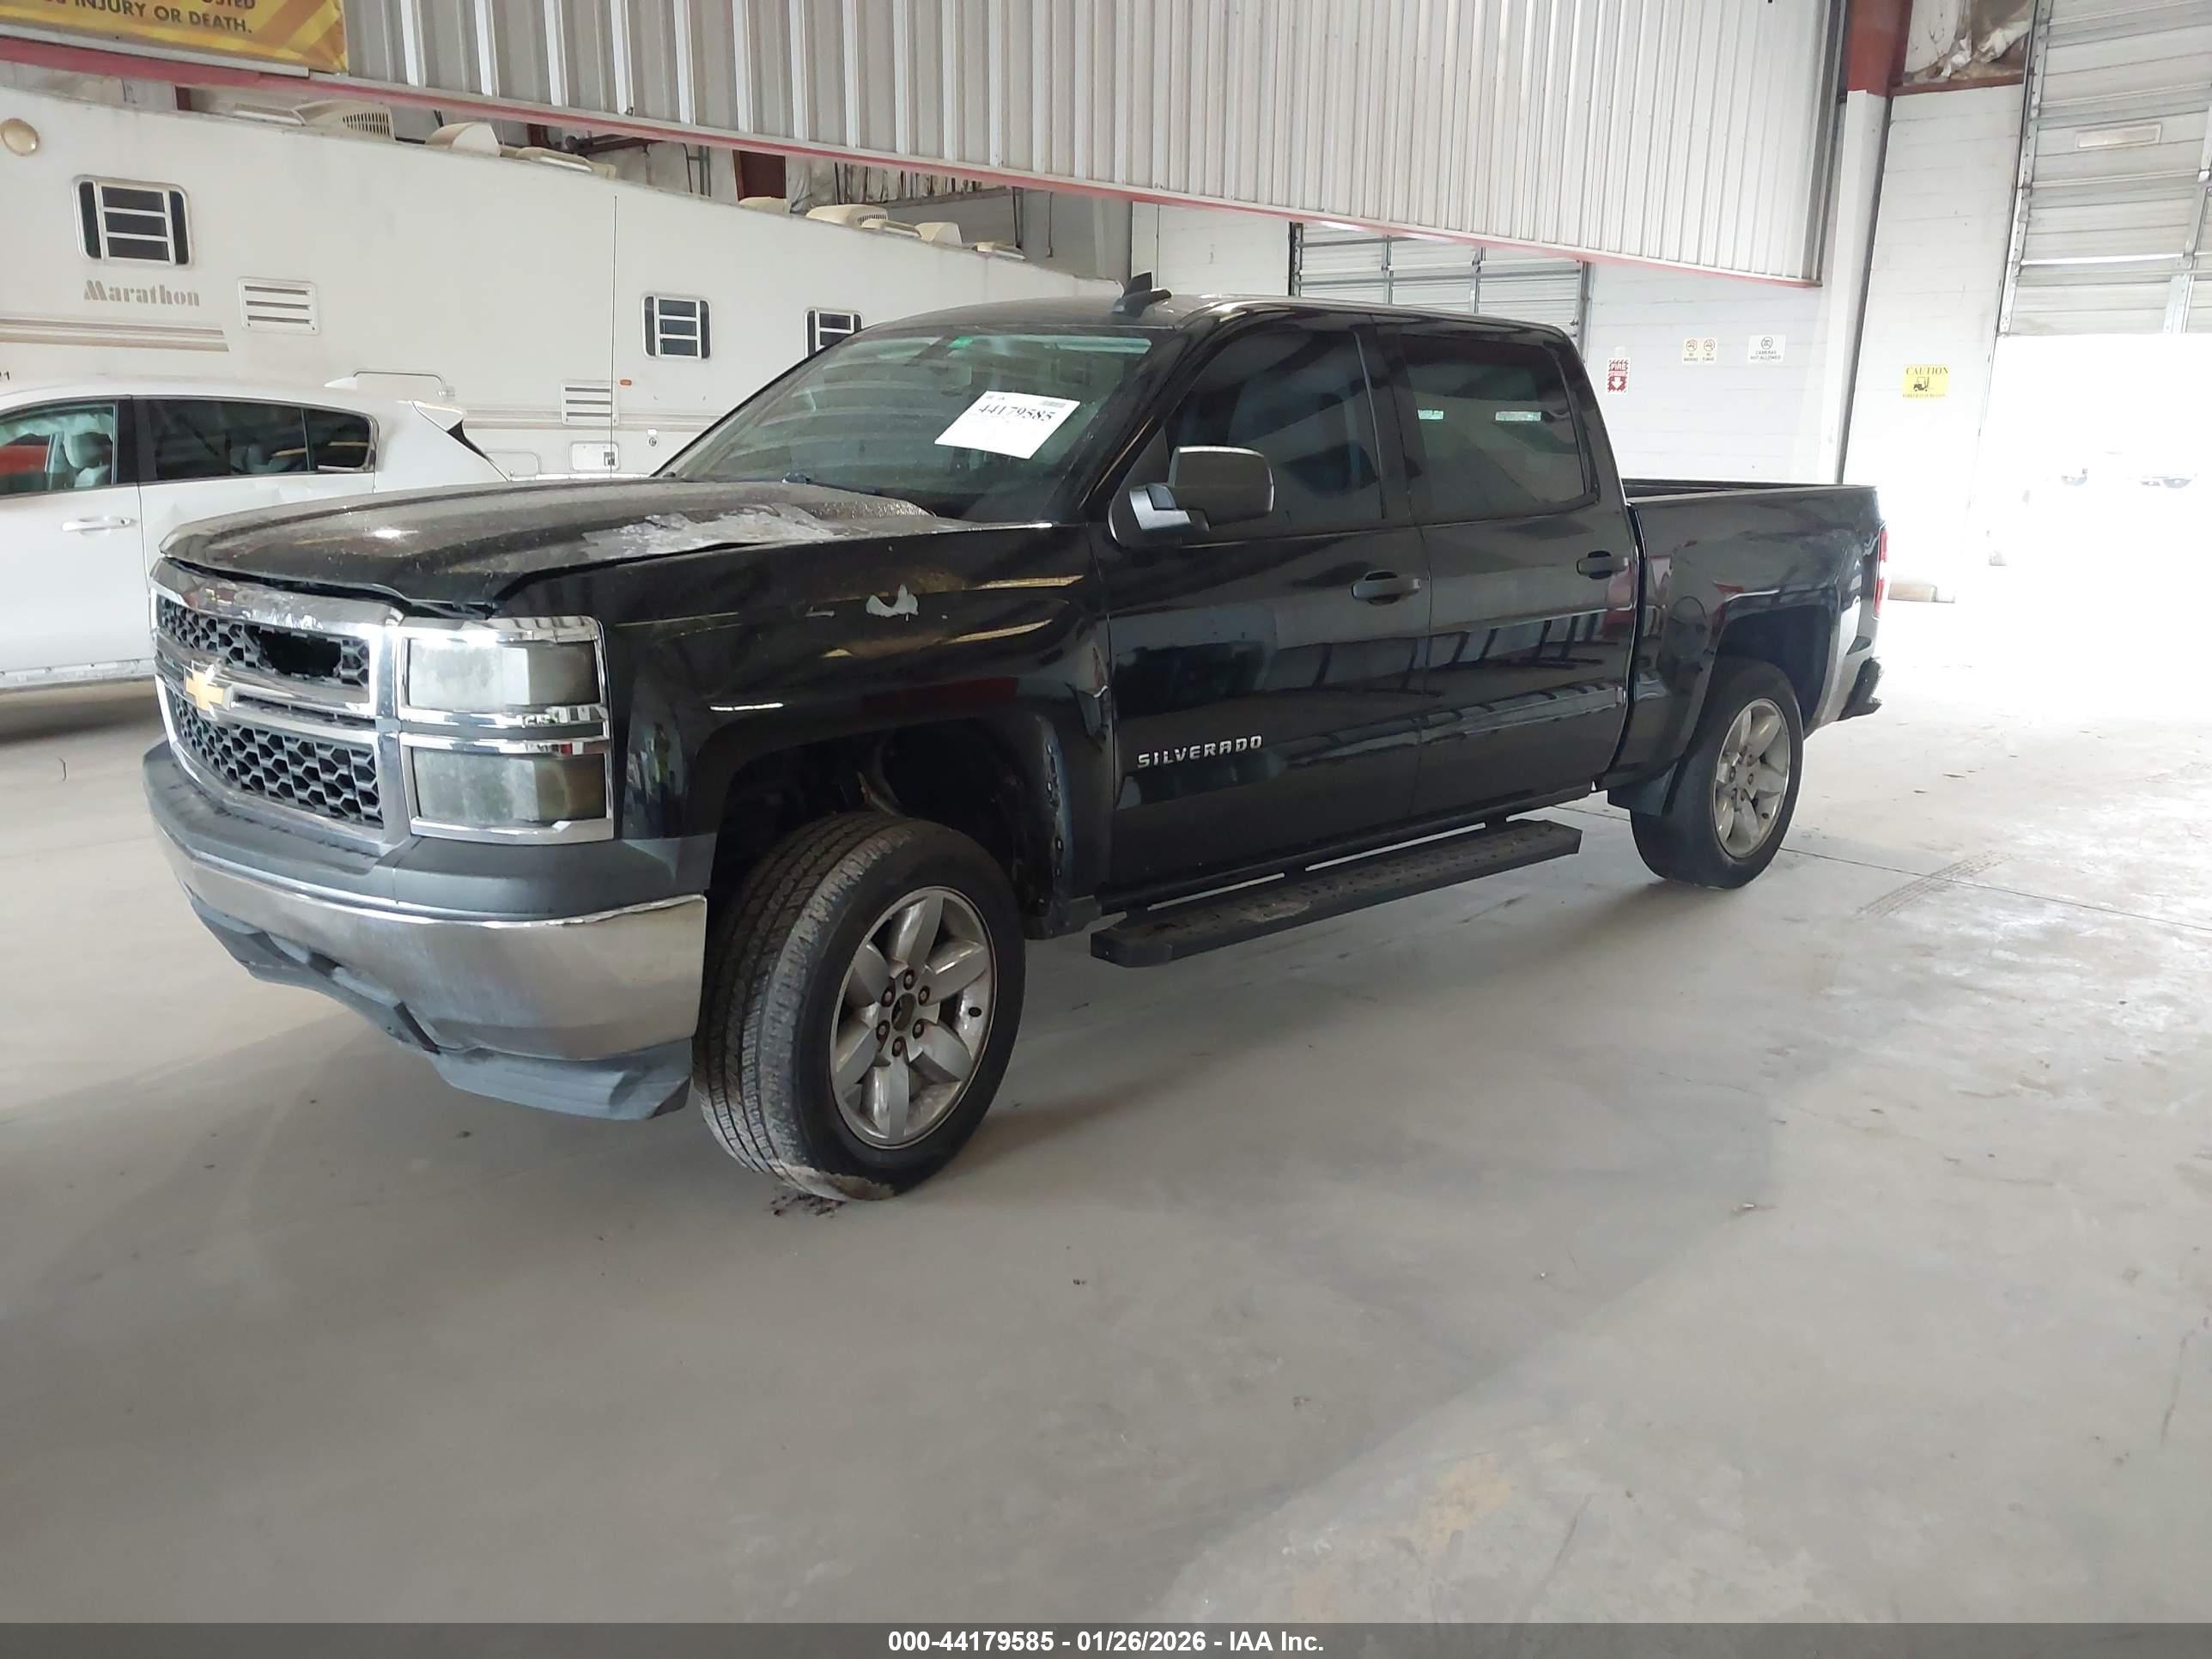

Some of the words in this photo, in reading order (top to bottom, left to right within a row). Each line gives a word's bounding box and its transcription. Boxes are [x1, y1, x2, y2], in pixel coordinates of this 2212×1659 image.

[154, 5, 182, 23] OR
[188, 10, 252, 33] DEATH.
[84, 279, 199, 307] Marathon
[1905, 367, 1948, 375] CAUTION
[979, 405, 1055, 422] 44179585
[1137, 735, 1262, 769] SILVERADO
